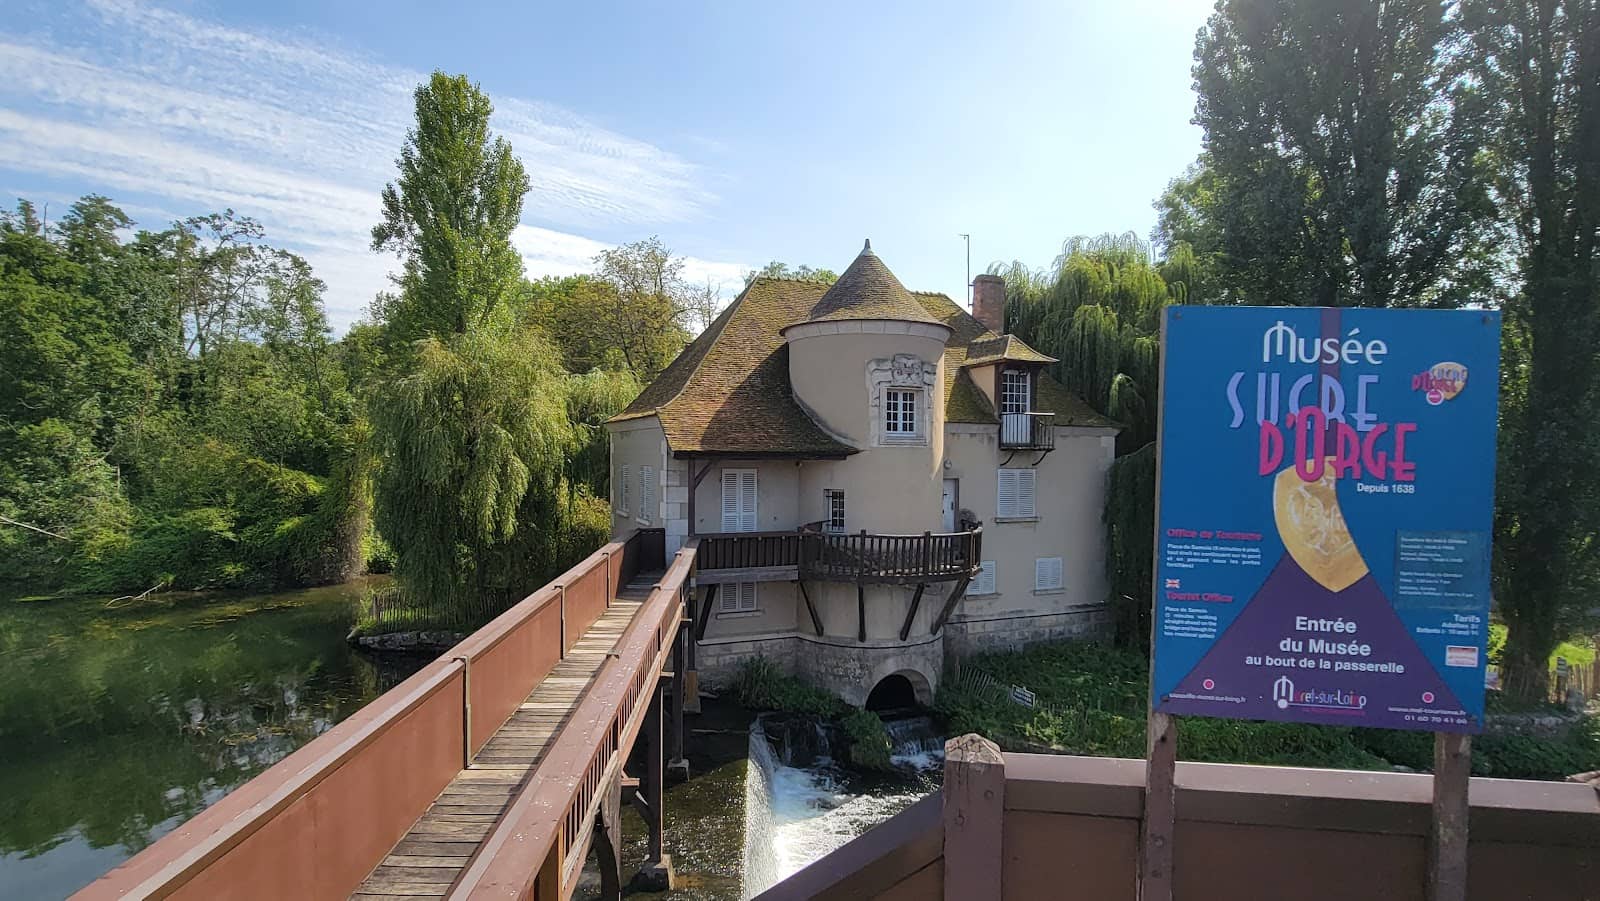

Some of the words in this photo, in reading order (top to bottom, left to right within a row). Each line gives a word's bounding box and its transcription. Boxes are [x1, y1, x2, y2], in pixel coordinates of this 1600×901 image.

[1263, 321, 1388, 365] Musée
[1227, 372, 1379, 431] SUCRE
[1258, 405, 1417, 483] D'ORGE
[1357, 482, 1389, 494] Depuis
[1392, 484, 1415, 494] 1638
[1295, 615, 1357, 634] Entrée
[1279, 637, 1303, 652] du
[1309, 638, 1371, 656] Musée
[1245, 655, 1262, 665] au
[1265, 655, 1296, 667] bout
[1298, 657, 1316, 669] de
[1319, 658, 1331, 669] la
[1334, 661, 1405, 673] passerelle
